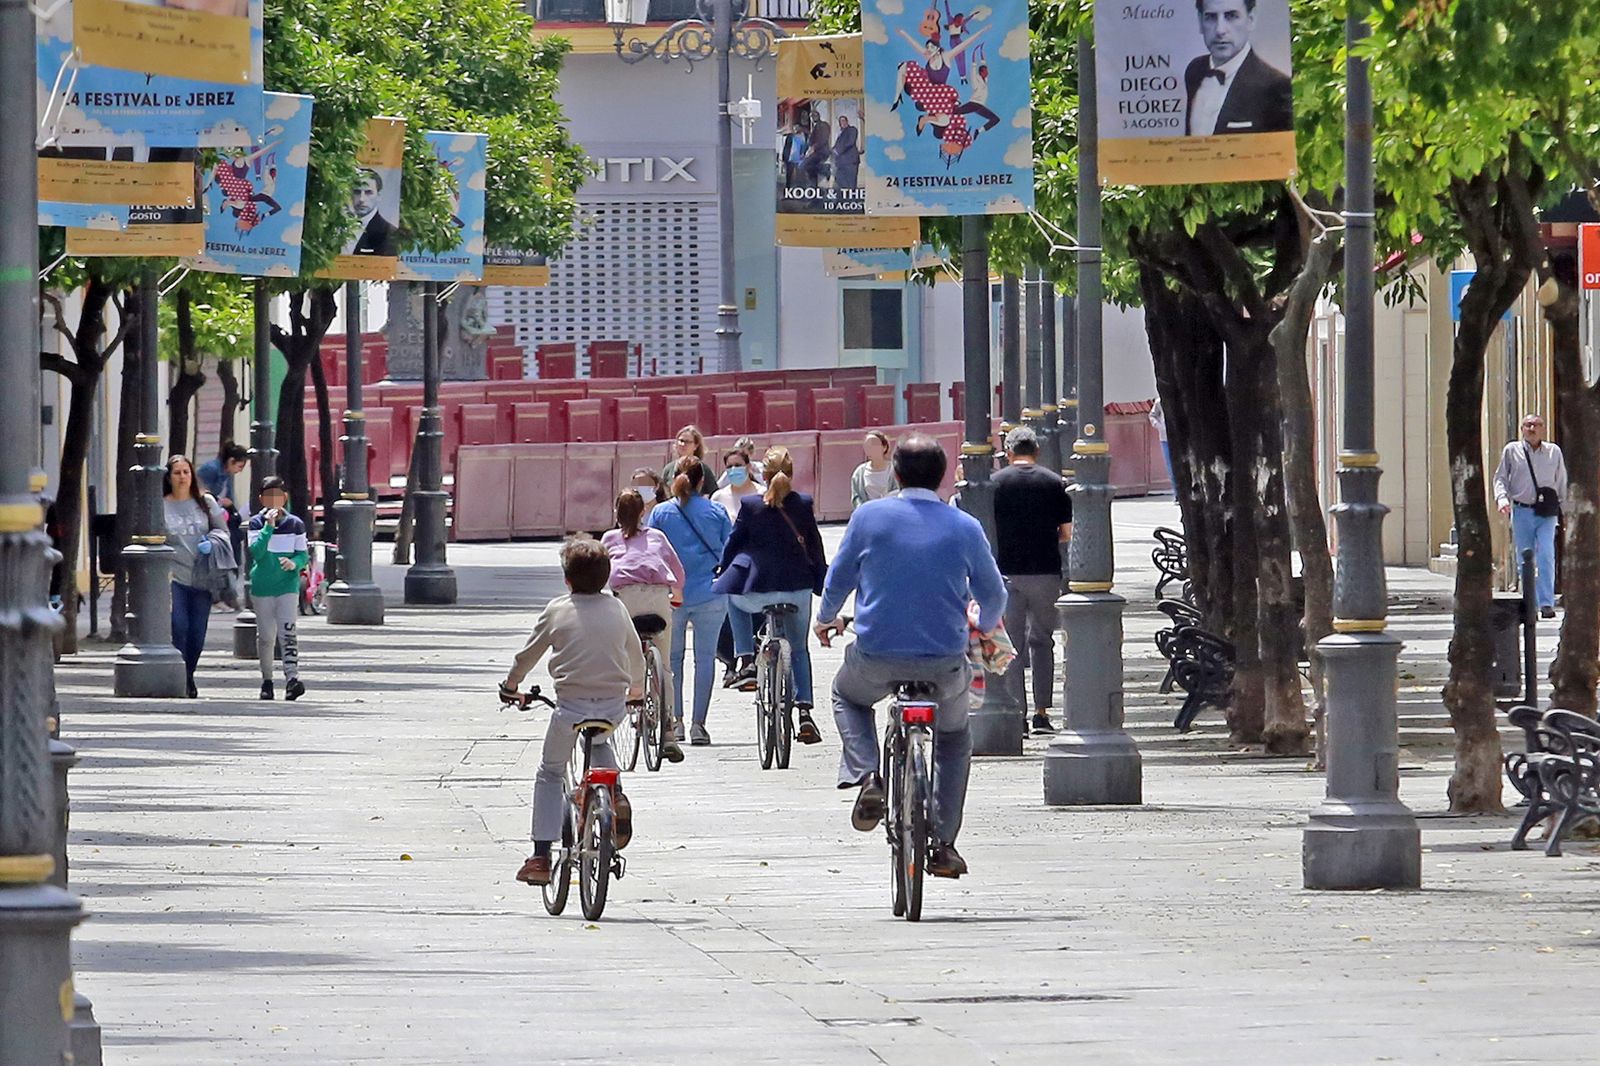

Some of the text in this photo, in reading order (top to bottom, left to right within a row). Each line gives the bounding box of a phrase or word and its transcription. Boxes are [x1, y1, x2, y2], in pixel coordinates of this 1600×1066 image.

[1122, 4, 1175, 20] Mucho
[1124, 54, 1170, 72] JUAN
[1120, 76, 1178, 92] DIEGO
[85, 91, 160, 106] FESTIVAL
[165, 95, 181, 107] DE
[185, 91, 235, 107] JEREZ
[1119, 94, 1182, 115] FLÓREZ
[1130, 118, 1180, 129] AGOSTO
[886, 174, 1013, 187] 24 FESTIVAL DE JEREZ
[784, 187, 865, 200] KOOL & THE
[823, 202, 834, 210] 10
[205, 242, 246, 254] FESTIVAL
[259, 247, 286, 256] JEREZ
